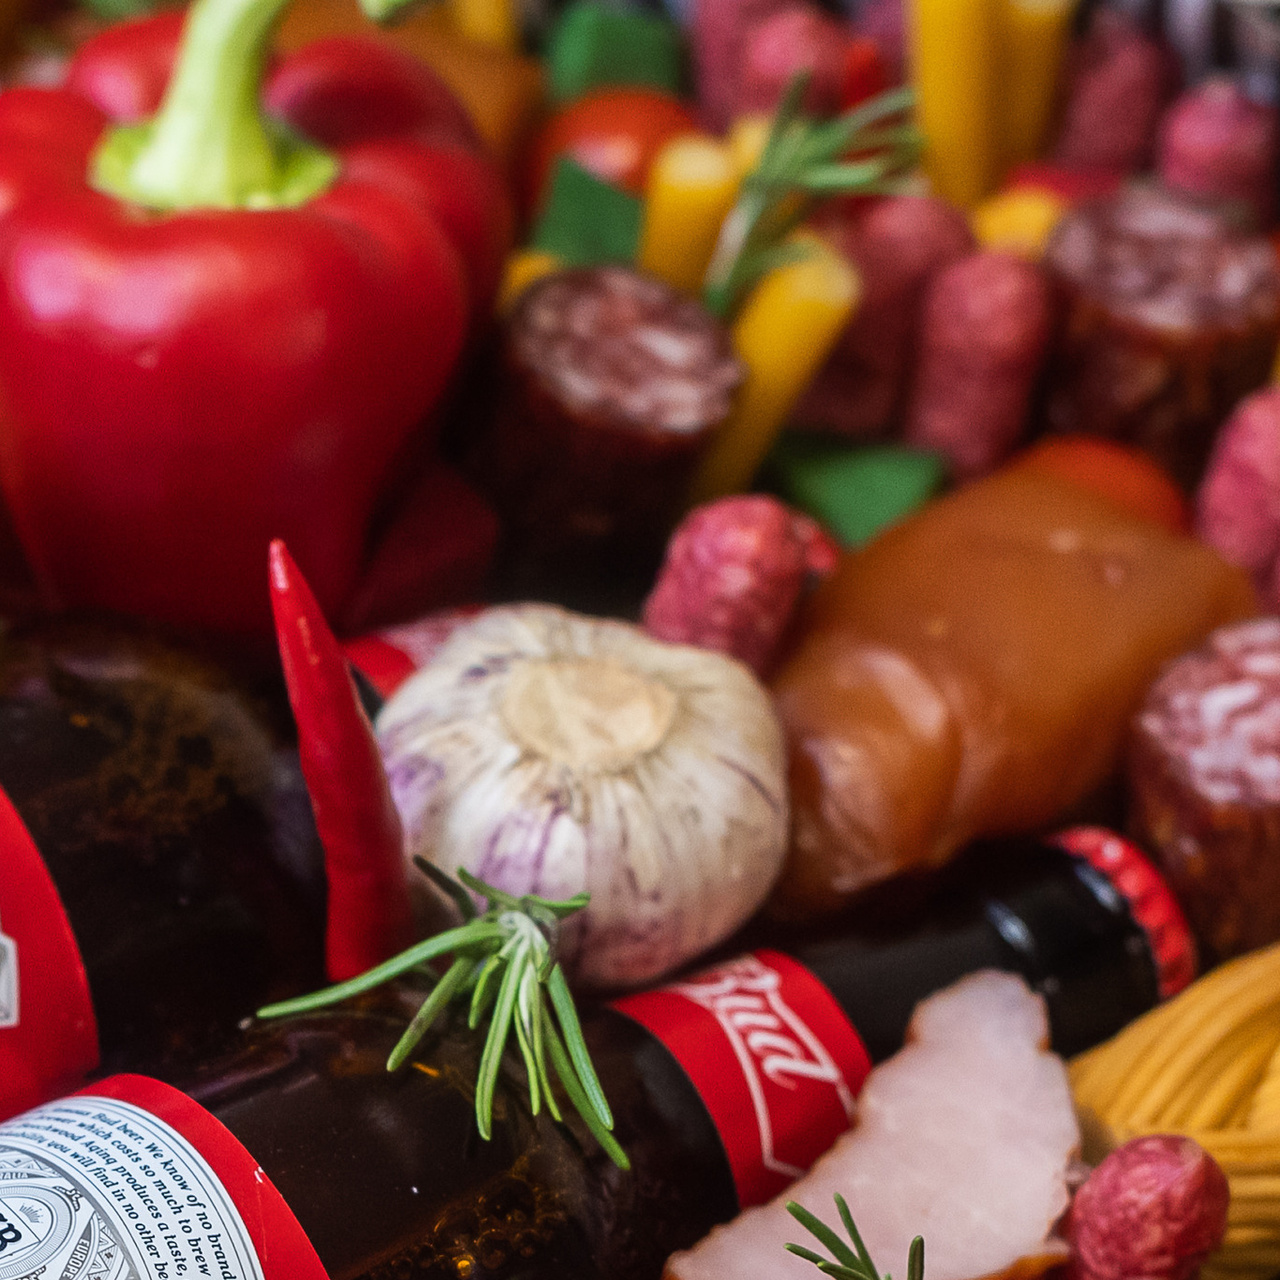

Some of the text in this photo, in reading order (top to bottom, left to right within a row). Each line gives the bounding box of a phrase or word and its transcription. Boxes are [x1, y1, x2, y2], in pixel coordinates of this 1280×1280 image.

[47, 1140, 72, 1153] you
[70, 1151, 97, 1168] will
[87, 1166, 119, 1189] find
[111, 1188, 126, 1202] in
[122, 1203, 139, 1220] no
[135, 1222, 160, 1258] other
[62, 1238, 89, 1280] EUROPE
[77, 1122, 113, 1140] which
[111, 1139, 142, 1163] costs
[139, 1164, 155, 1177] so
[152, 1179, 185, 1215] much
[178, 1219, 192, 1234] to
[187, 1237, 211, 1277] brew
[81, 1140, 118, 1165] Aging
[112, 1165, 162, 1219] produces
[157, 1222, 169, 1231] a
[164, 1234, 187, 1276] taste,
[93, 1112, 122, 1126] Bud
[117, 1123, 145, 1145] beer.
[145, 1142, 164, 1159] We
[161, 1159, 192, 1191] know
[186, 1194, 206, 1210] of
[196, 1212, 212, 1230] no
[207, 1233, 237, 1280] brand
